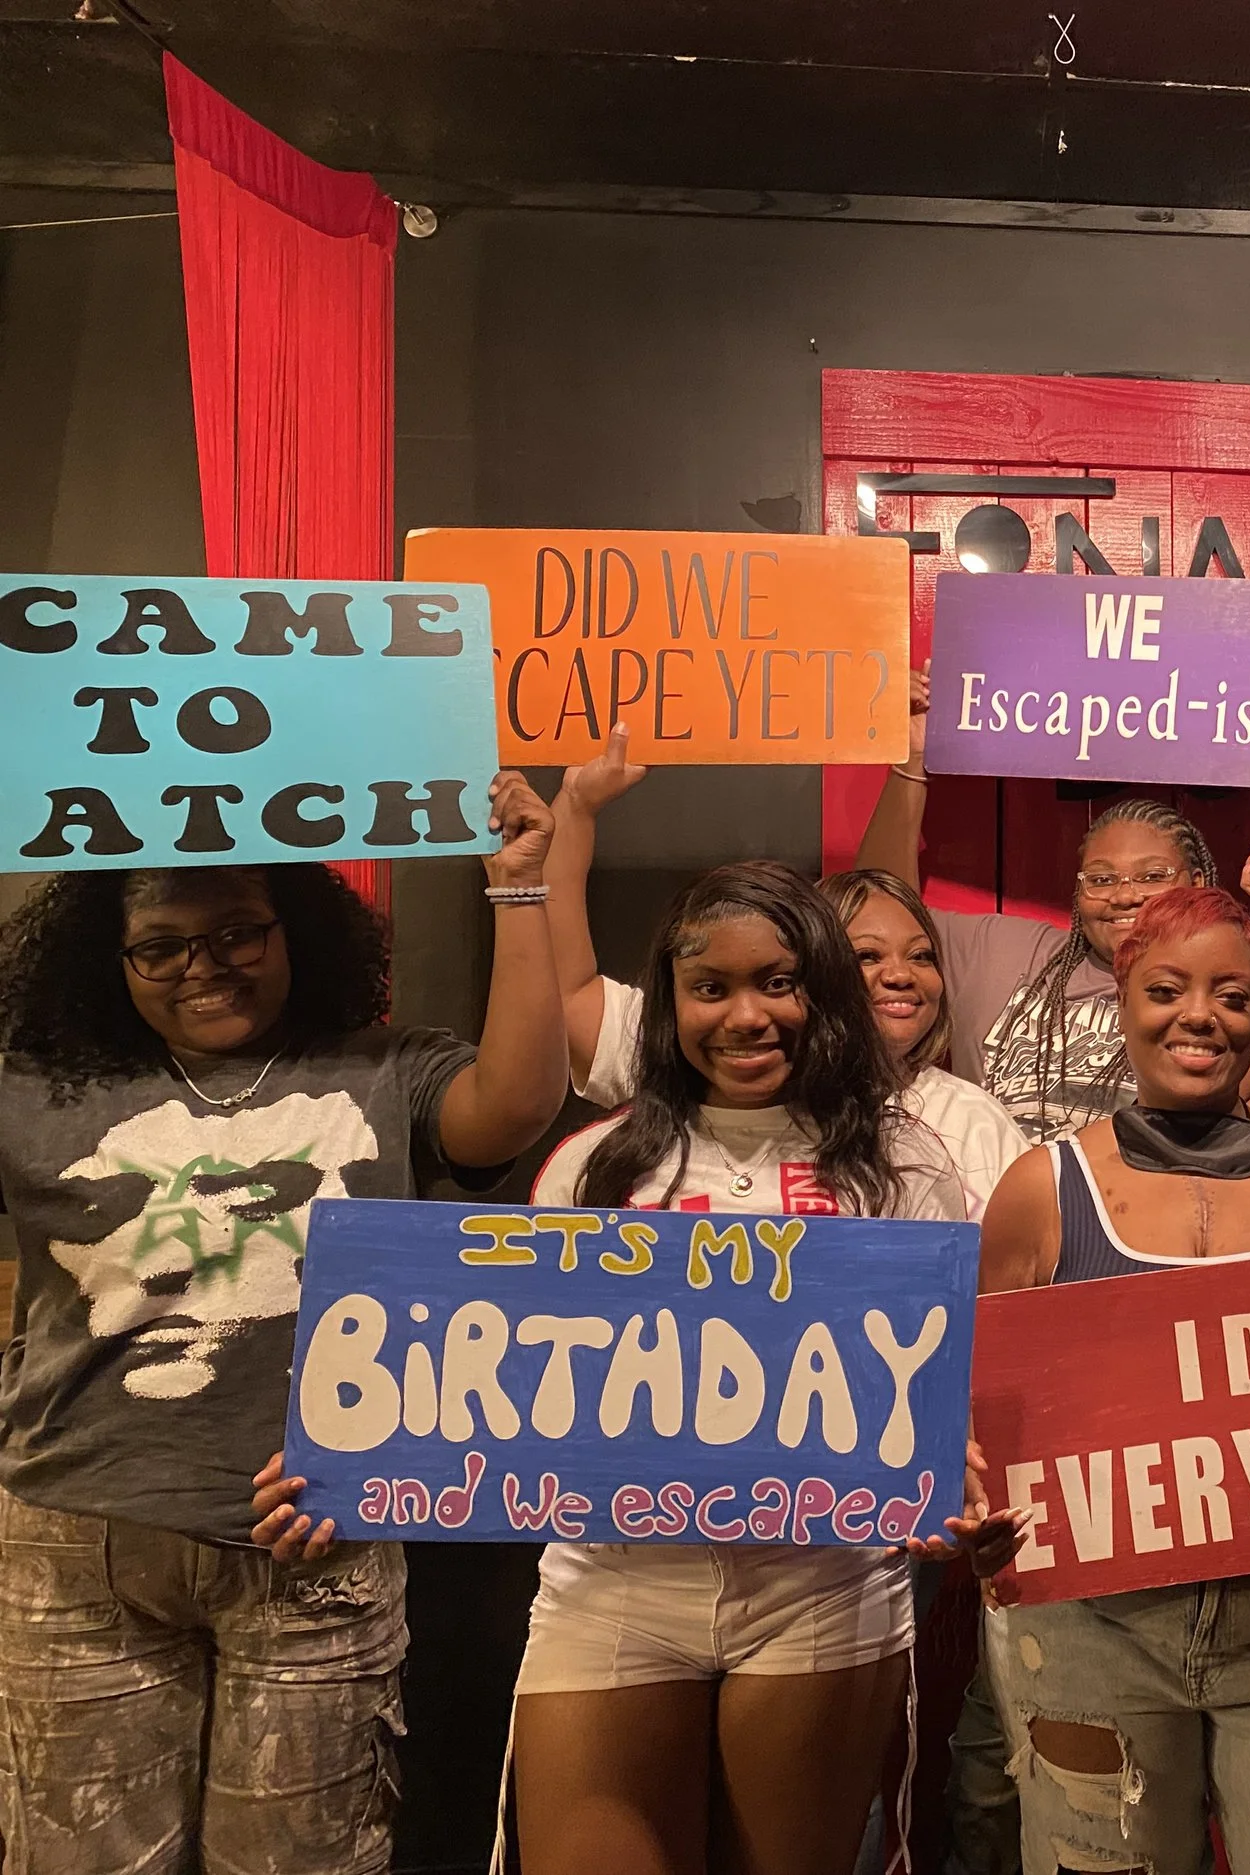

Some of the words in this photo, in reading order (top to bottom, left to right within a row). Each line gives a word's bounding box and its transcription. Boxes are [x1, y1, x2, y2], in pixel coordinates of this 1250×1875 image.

[0, 586, 464, 656] CAME
[533, 546, 639, 639] DID
[660, 549, 780, 641] WE
[1085, 592, 1164, 661] WE
[73, 686, 272, 754] TO
[493, 646, 695, 741] CAPE
[714, 648, 890, 741] YET?
[18, 779, 478, 858] ATCH
[458, 1213, 660, 1275] IT'S
[686, 1217, 807, 1302] MY
[1174, 1319, 1204, 1403] I
[357, 1450, 486, 1529] and
[610, 1470, 934, 1545] escaped
